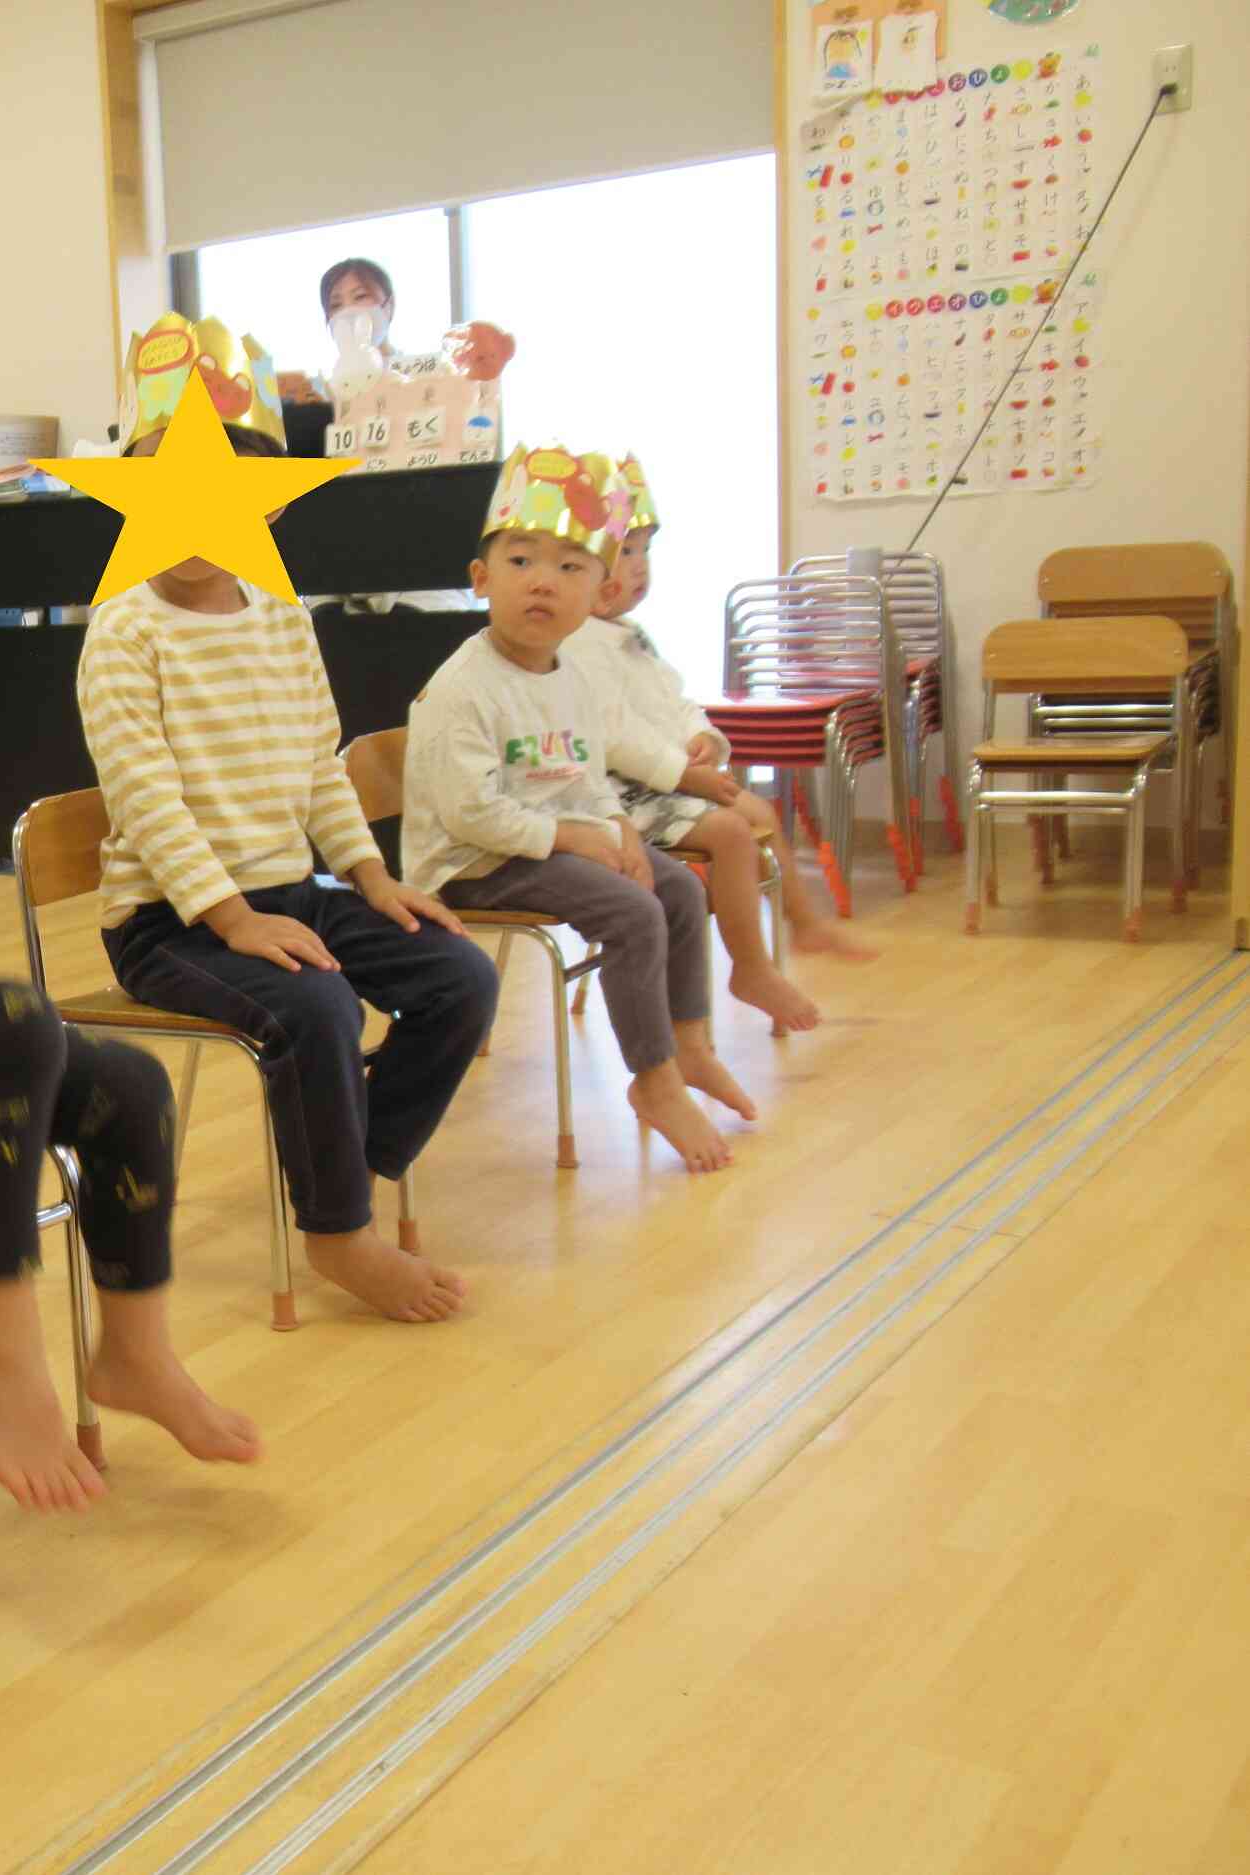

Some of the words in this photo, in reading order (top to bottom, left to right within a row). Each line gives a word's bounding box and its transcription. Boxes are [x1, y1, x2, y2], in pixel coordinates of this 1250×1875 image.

[391, 356, 437, 374] きょうは
[367, 421, 386, 442] 16
[406, 415, 439, 439] もく
[334, 429, 353, 450] 10
[459, 448, 490, 463] てんき
